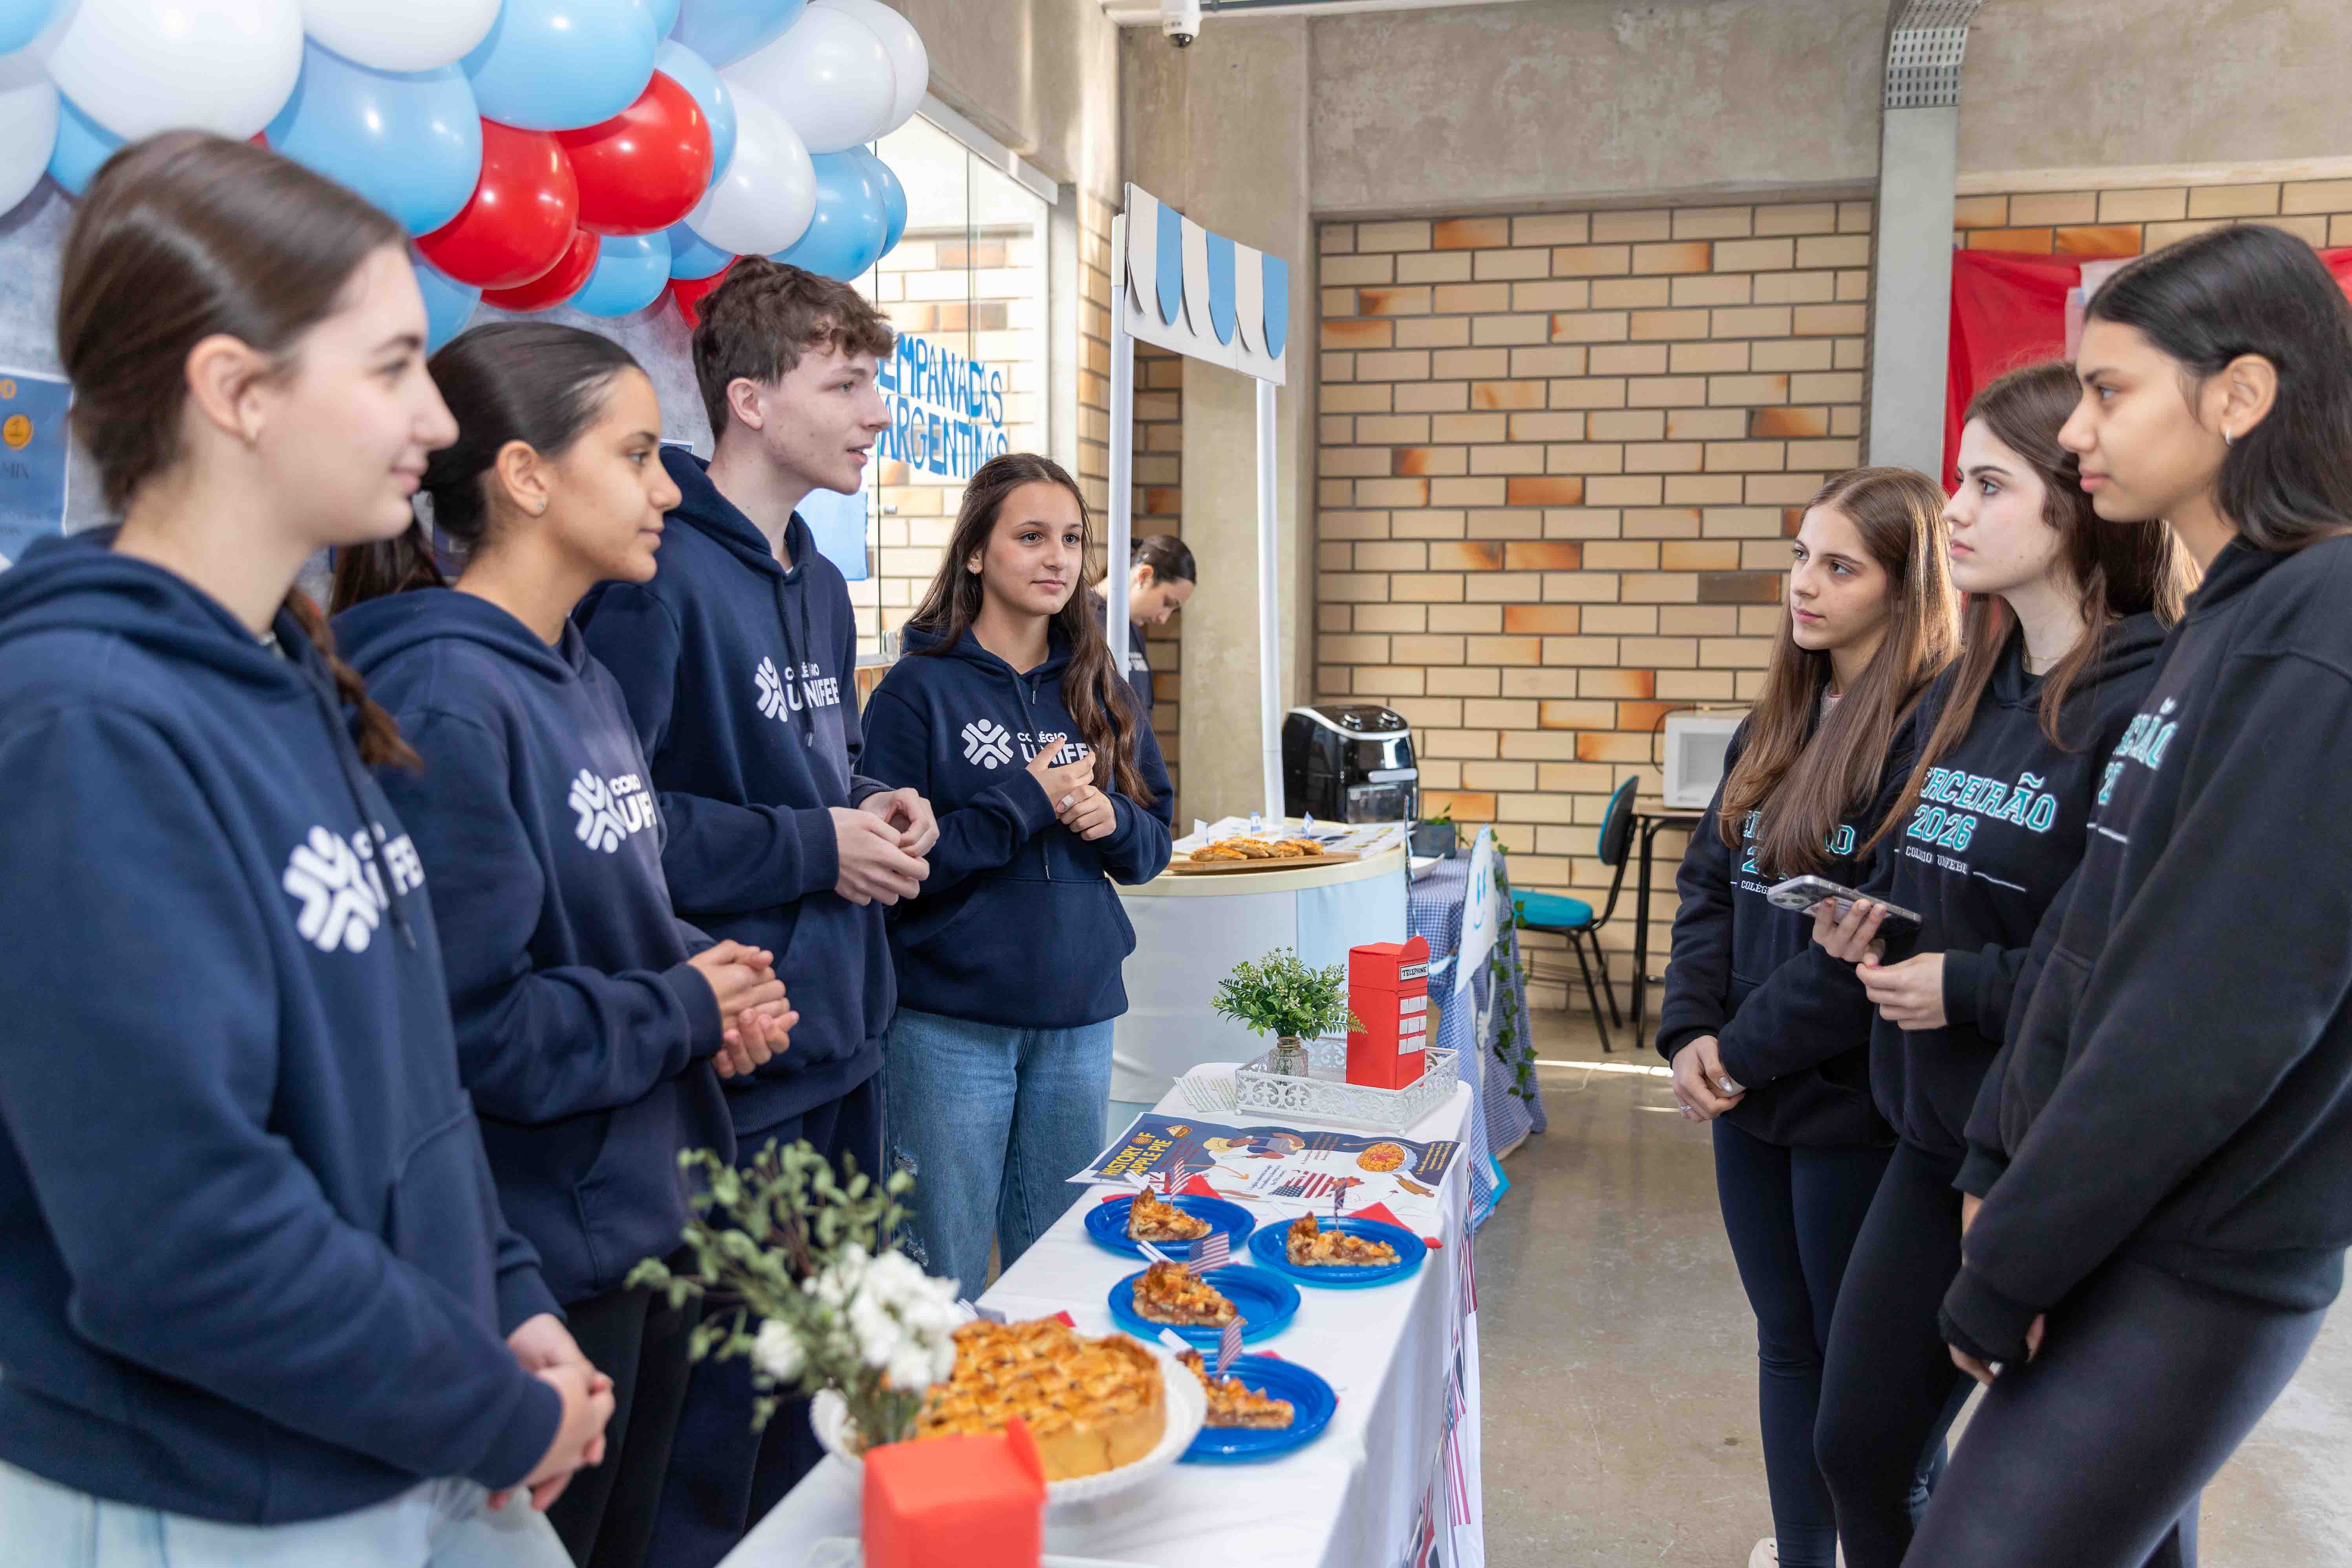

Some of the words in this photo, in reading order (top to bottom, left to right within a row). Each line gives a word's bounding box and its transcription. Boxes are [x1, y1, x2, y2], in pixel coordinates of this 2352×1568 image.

[1906, 804, 1977, 852] 2026
[1741, 880, 1768, 894] COLÉG
[1402, 967, 1426, 976] TELEPHONE
[1099, 1145, 1144, 1176] HISTORY
[1126, 1151, 1162, 1175] APPLE
[1147, 1139, 1173, 1152] PIE
